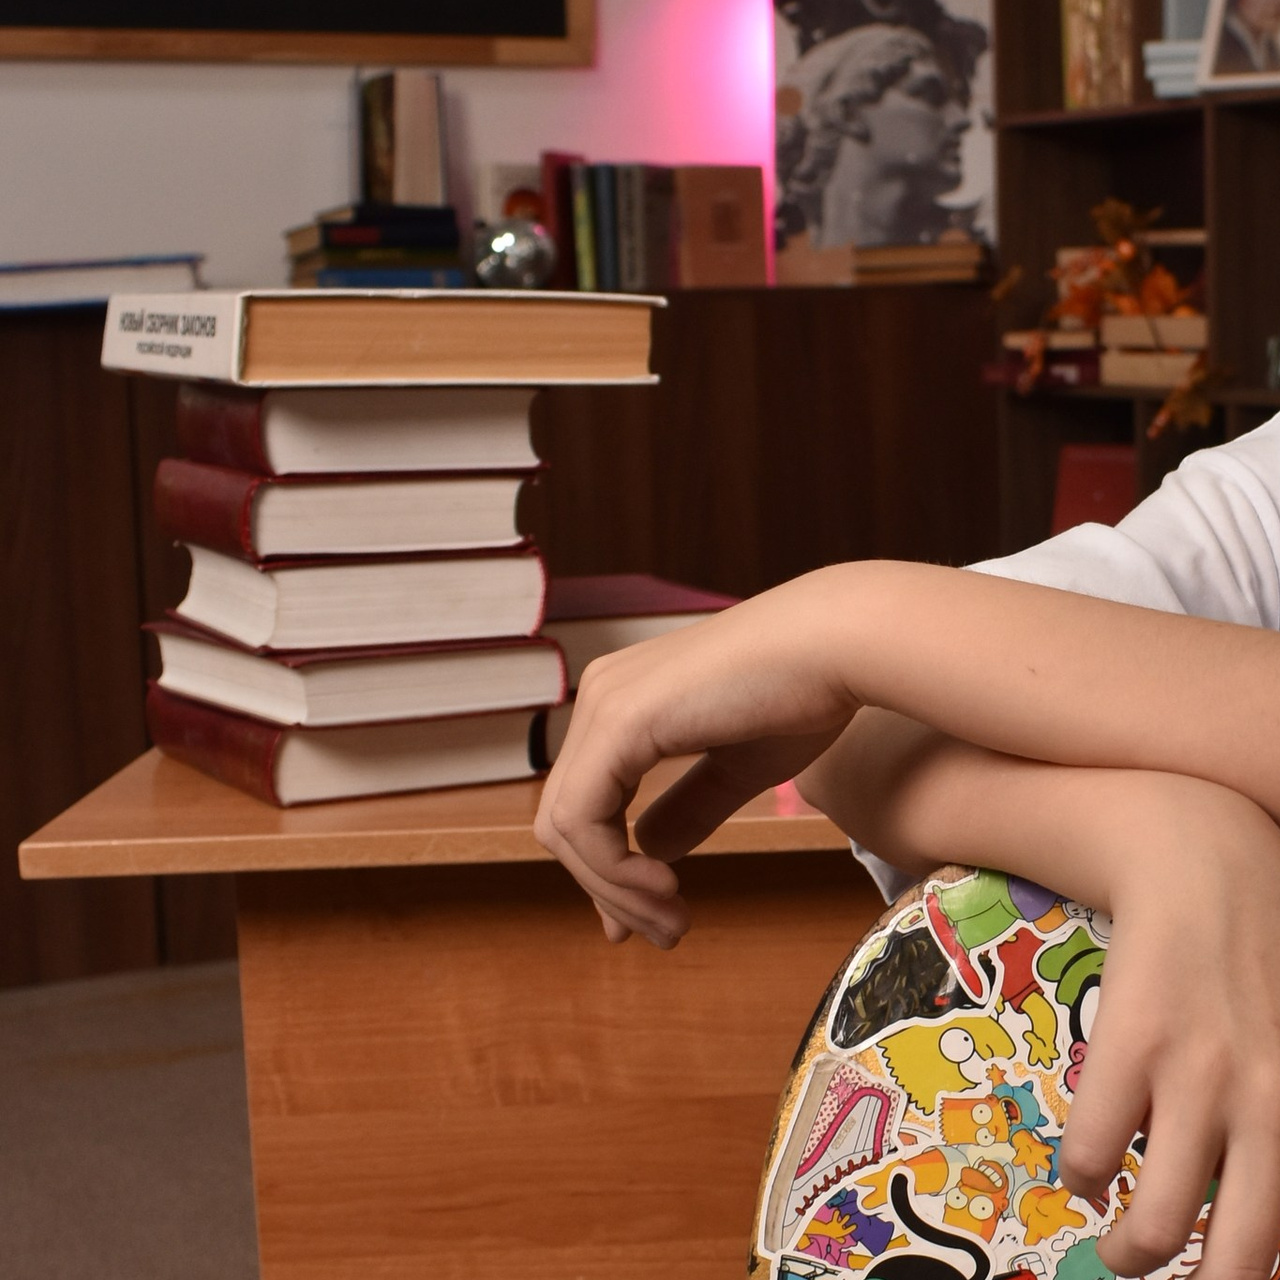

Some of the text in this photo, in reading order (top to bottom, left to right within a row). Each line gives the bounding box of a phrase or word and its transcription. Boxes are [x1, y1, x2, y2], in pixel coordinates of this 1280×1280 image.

[120, 308, 217, 338] НОВЫЙ СБОРНИК ЗАКОНОВ
